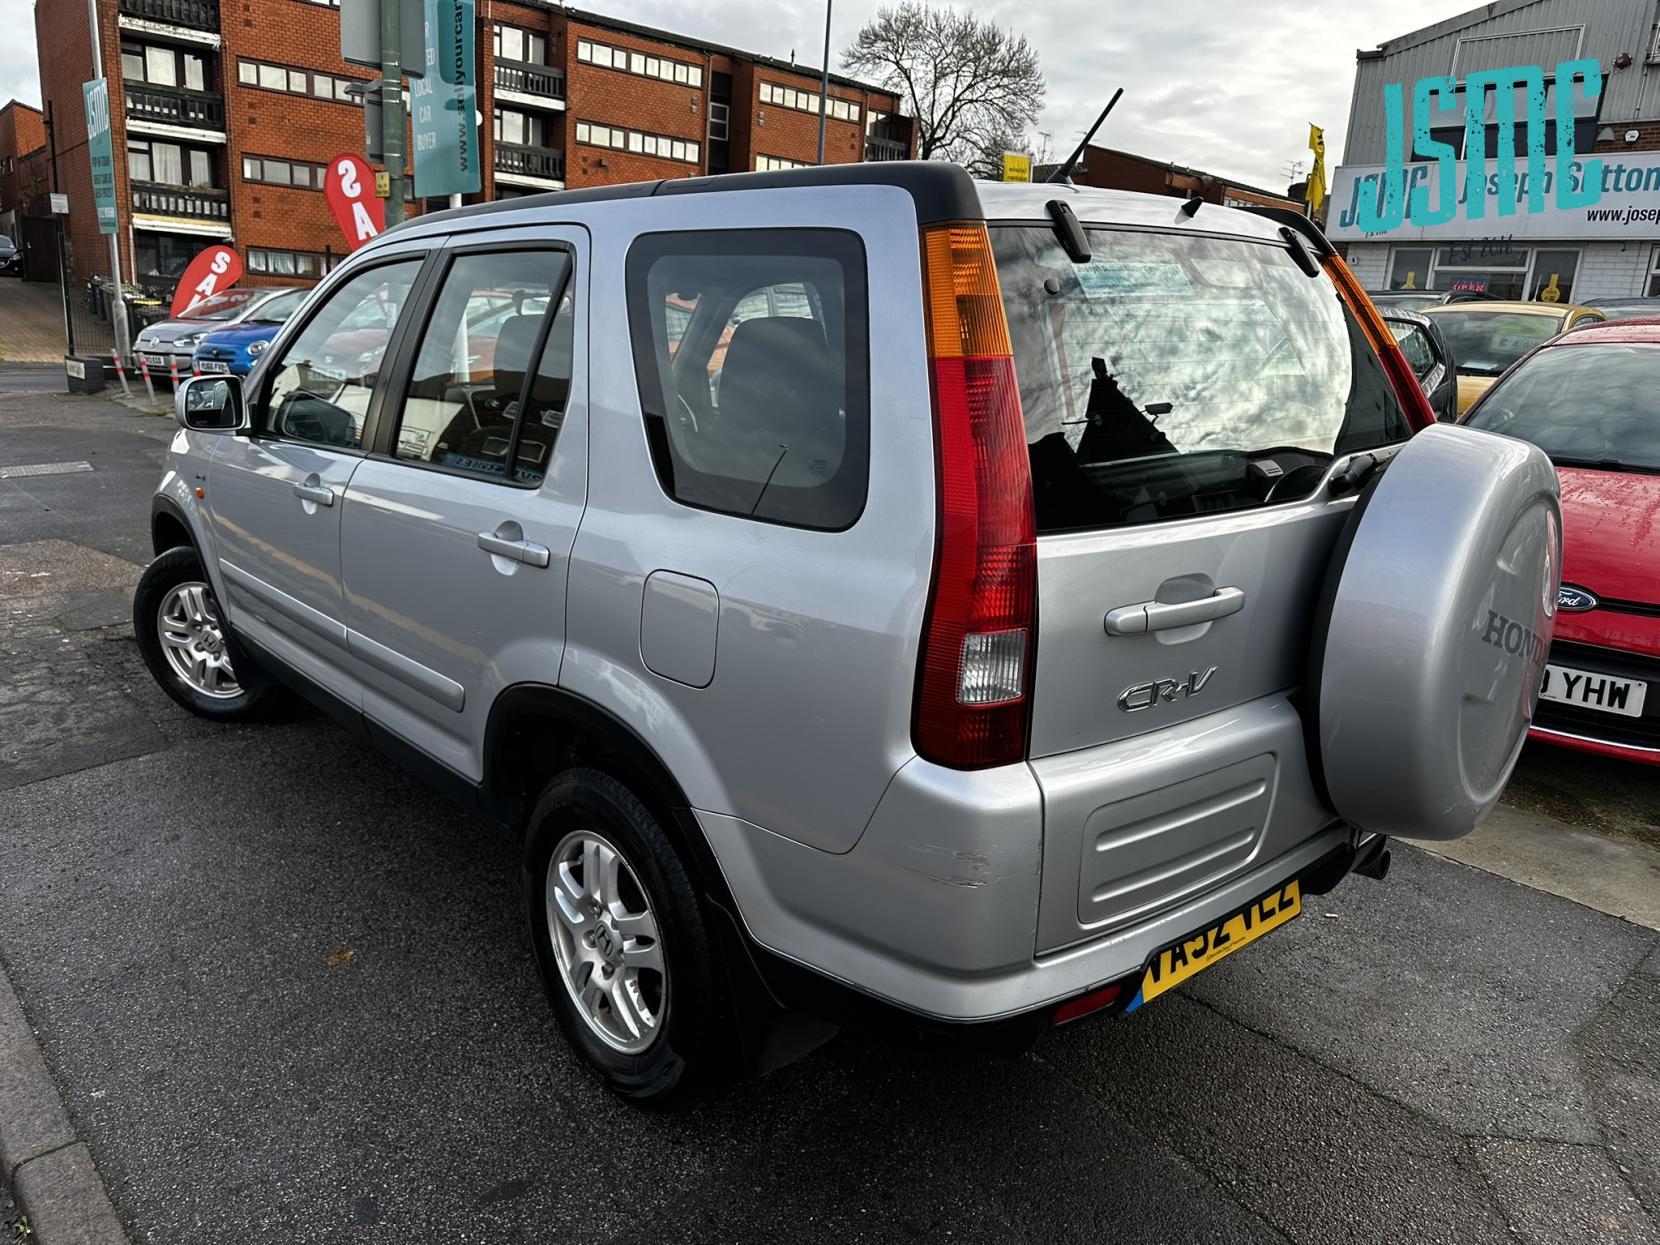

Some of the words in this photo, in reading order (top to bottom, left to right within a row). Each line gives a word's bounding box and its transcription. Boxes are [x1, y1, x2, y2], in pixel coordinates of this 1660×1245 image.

[414, 78, 434, 97] LOCAL
[419, 105, 432, 123] CAR
[417, 131, 437, 151] BUYER
[1567, 161, 1660, 193] Stton
[1453, 281, 1485, 292] OPEN
[1482, 609, 1547, 668] HOND
[1117, 665, 1218, 712] CR-V
[1563, 671, 1631, 710] YHW
